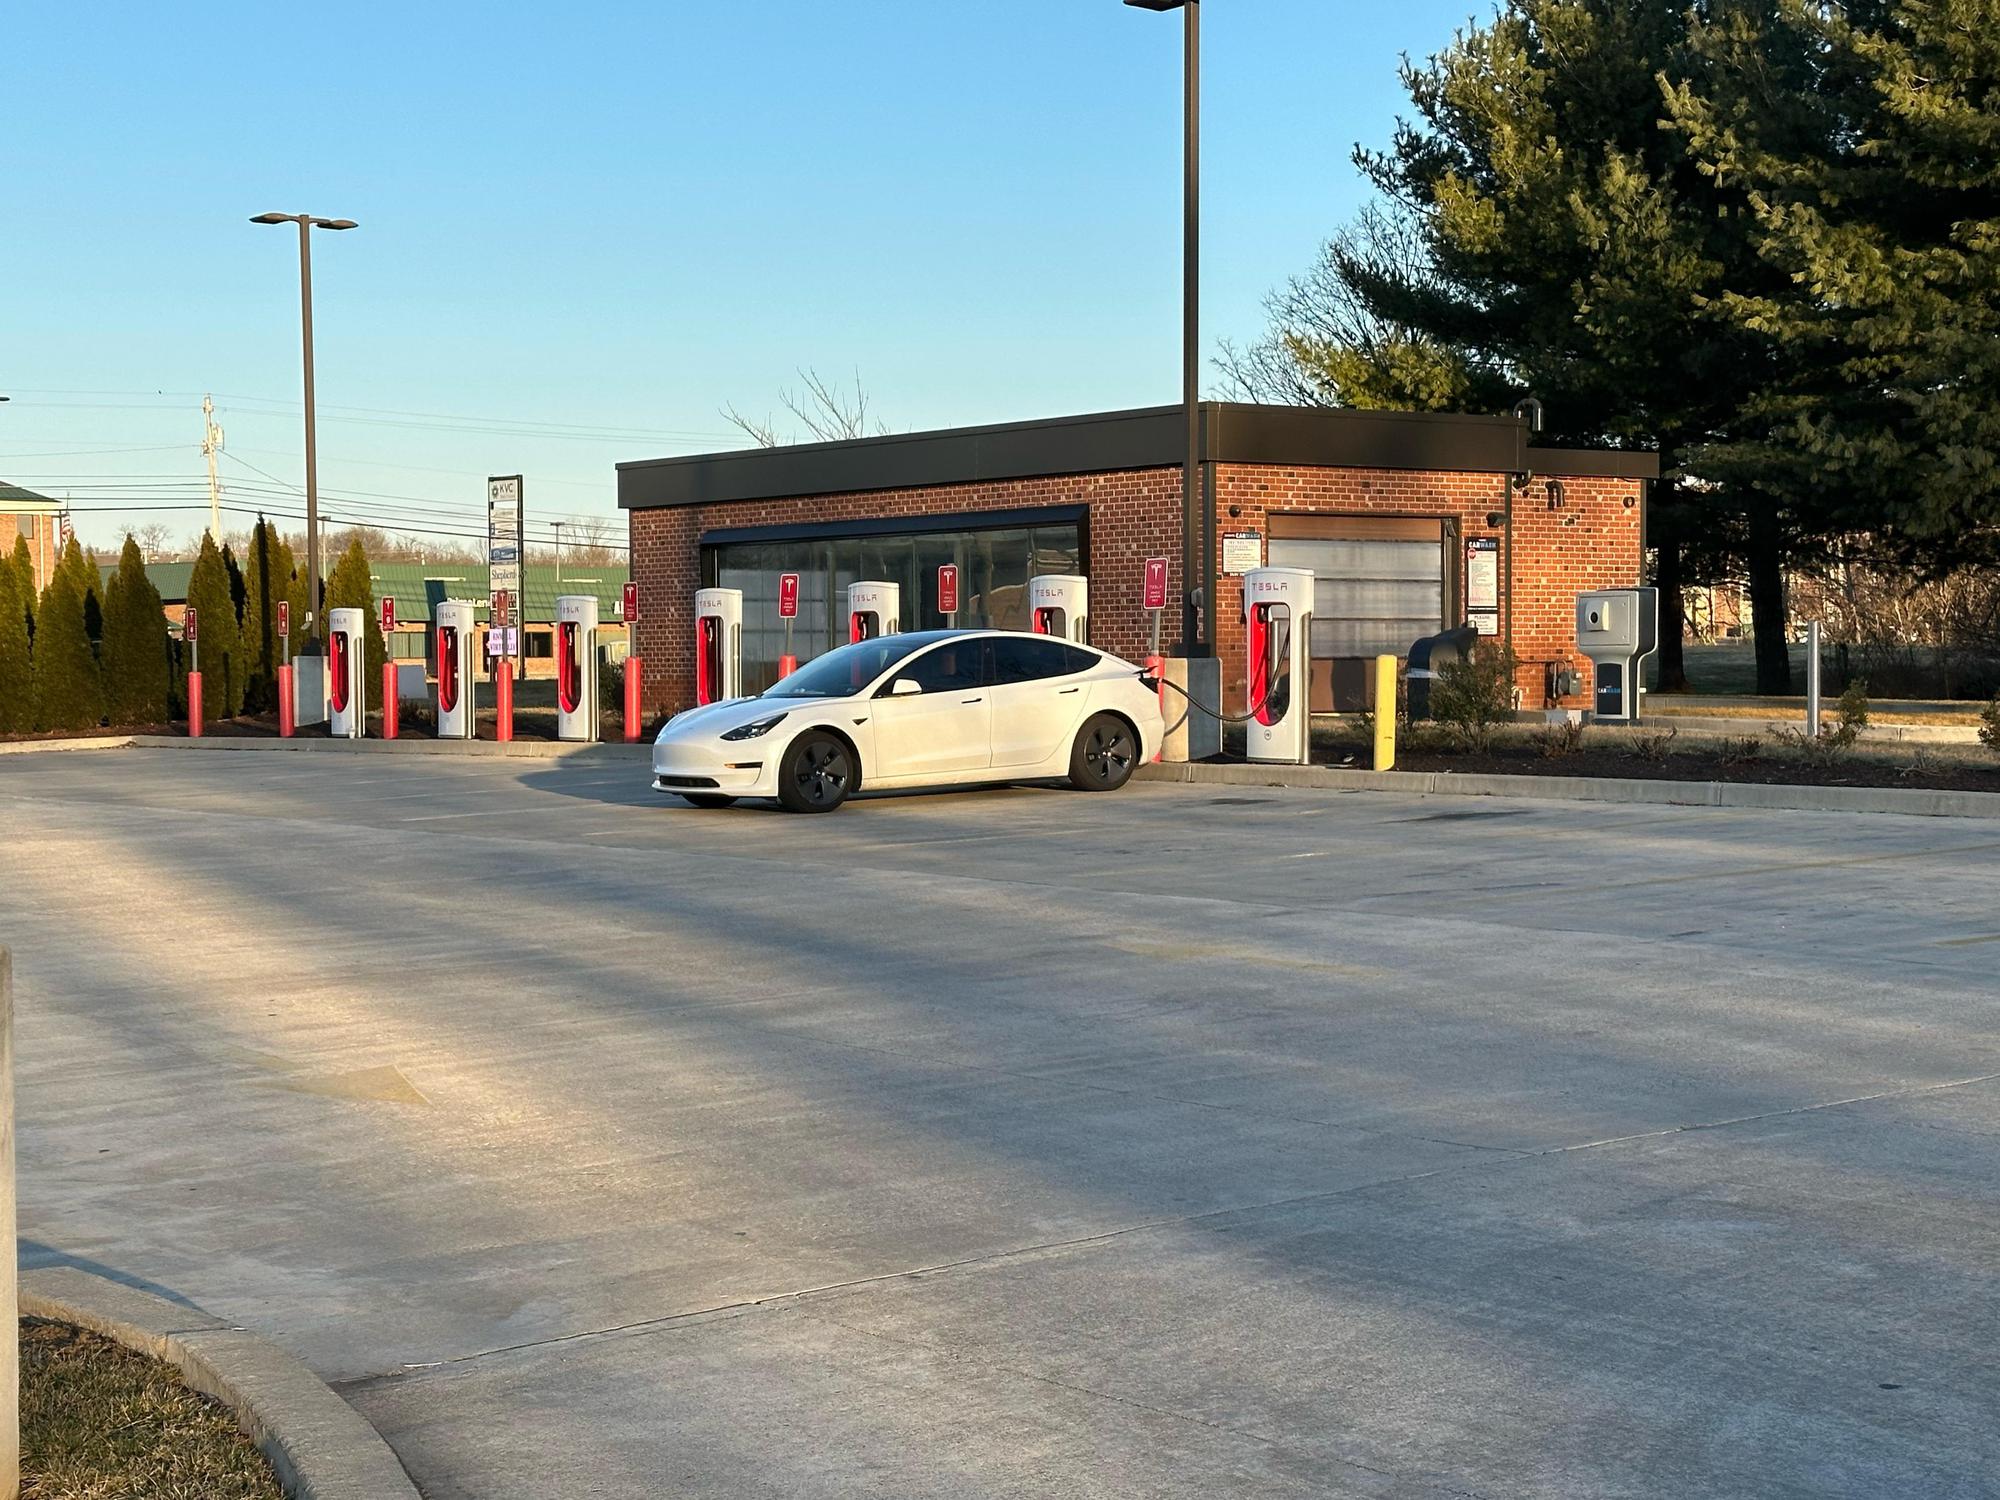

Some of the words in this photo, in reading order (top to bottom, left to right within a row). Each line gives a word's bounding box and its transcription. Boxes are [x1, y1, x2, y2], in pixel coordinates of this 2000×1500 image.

[500, 483, 513, 493] KVC
[1252, 582, 1288, 591] TESLA
[1035, 588, 1064, 596] TESLA
[853, 594, 877, 602] TESLA
